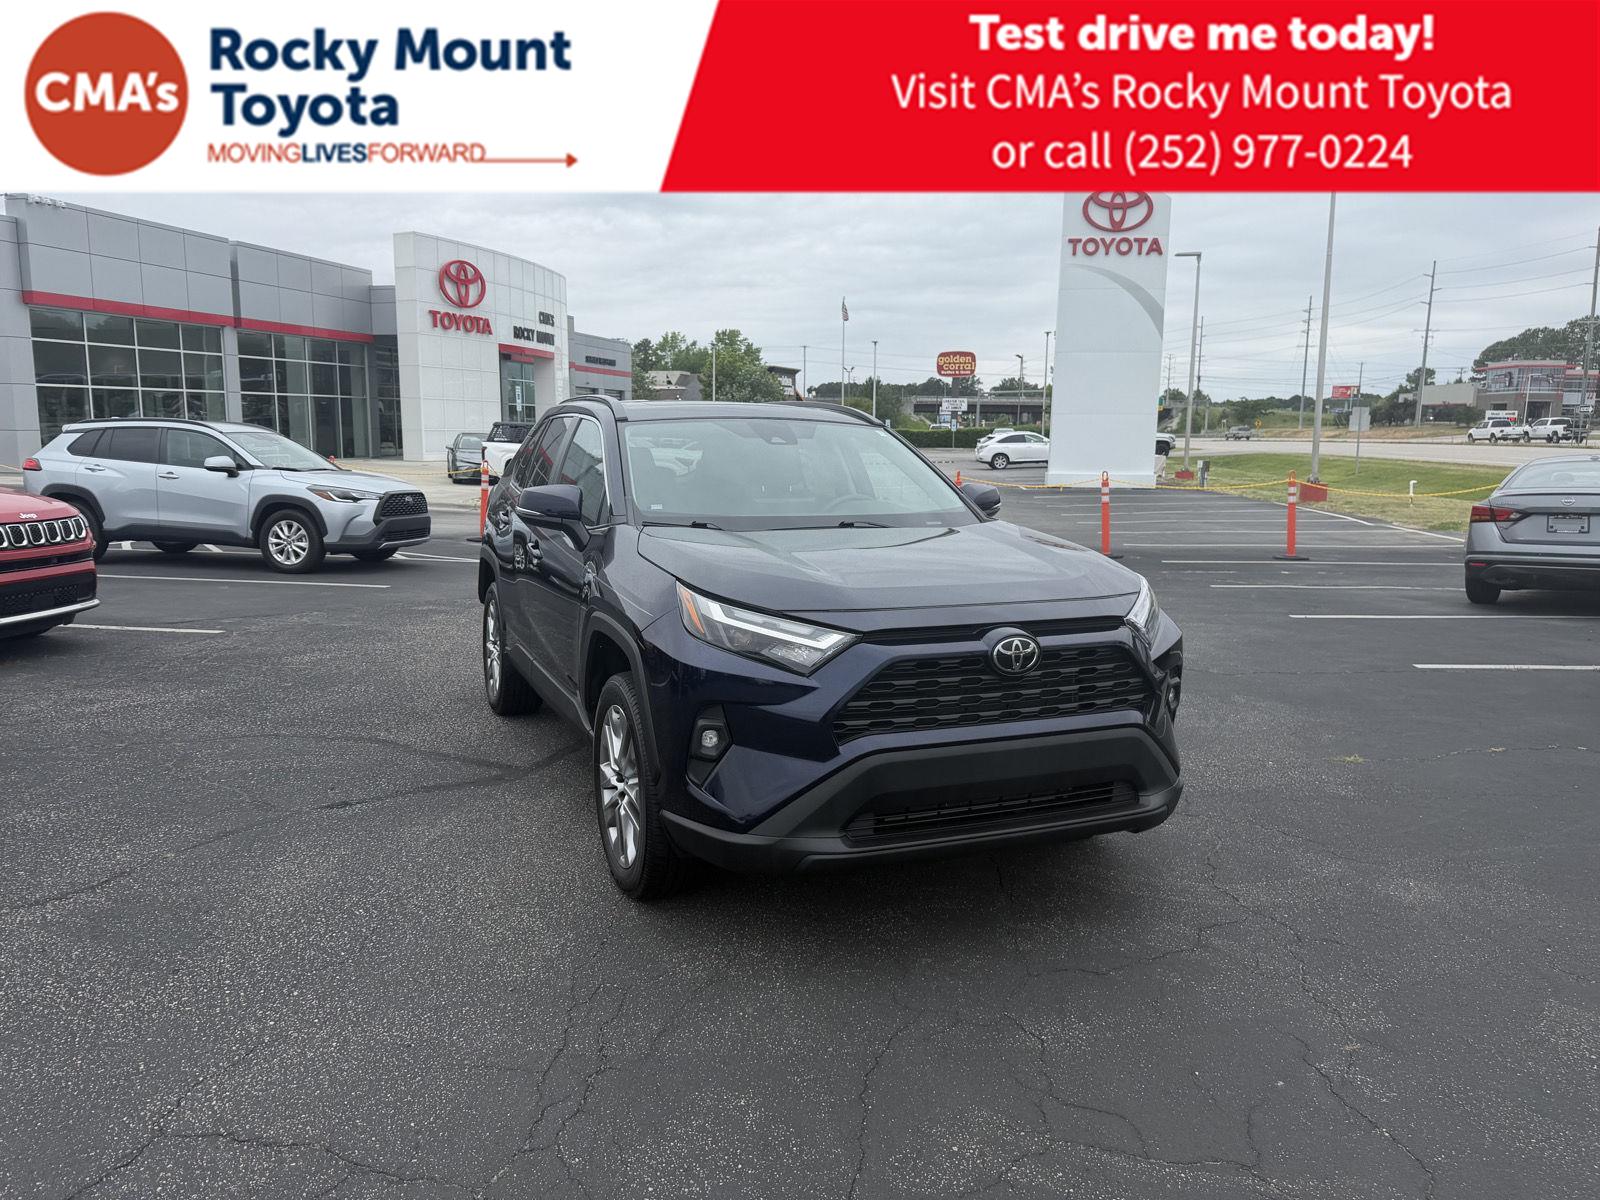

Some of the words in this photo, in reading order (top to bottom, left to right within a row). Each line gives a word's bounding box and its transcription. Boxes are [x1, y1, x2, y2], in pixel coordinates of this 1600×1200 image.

[1068, 237, 1164, 256] TOYOTA
[429, 310, 493, 335] TOYOTA
[513, 326, 535, 342] ROCKY
[938, 355, 972, 365] golden
[943, 362, 975, 370] corral
